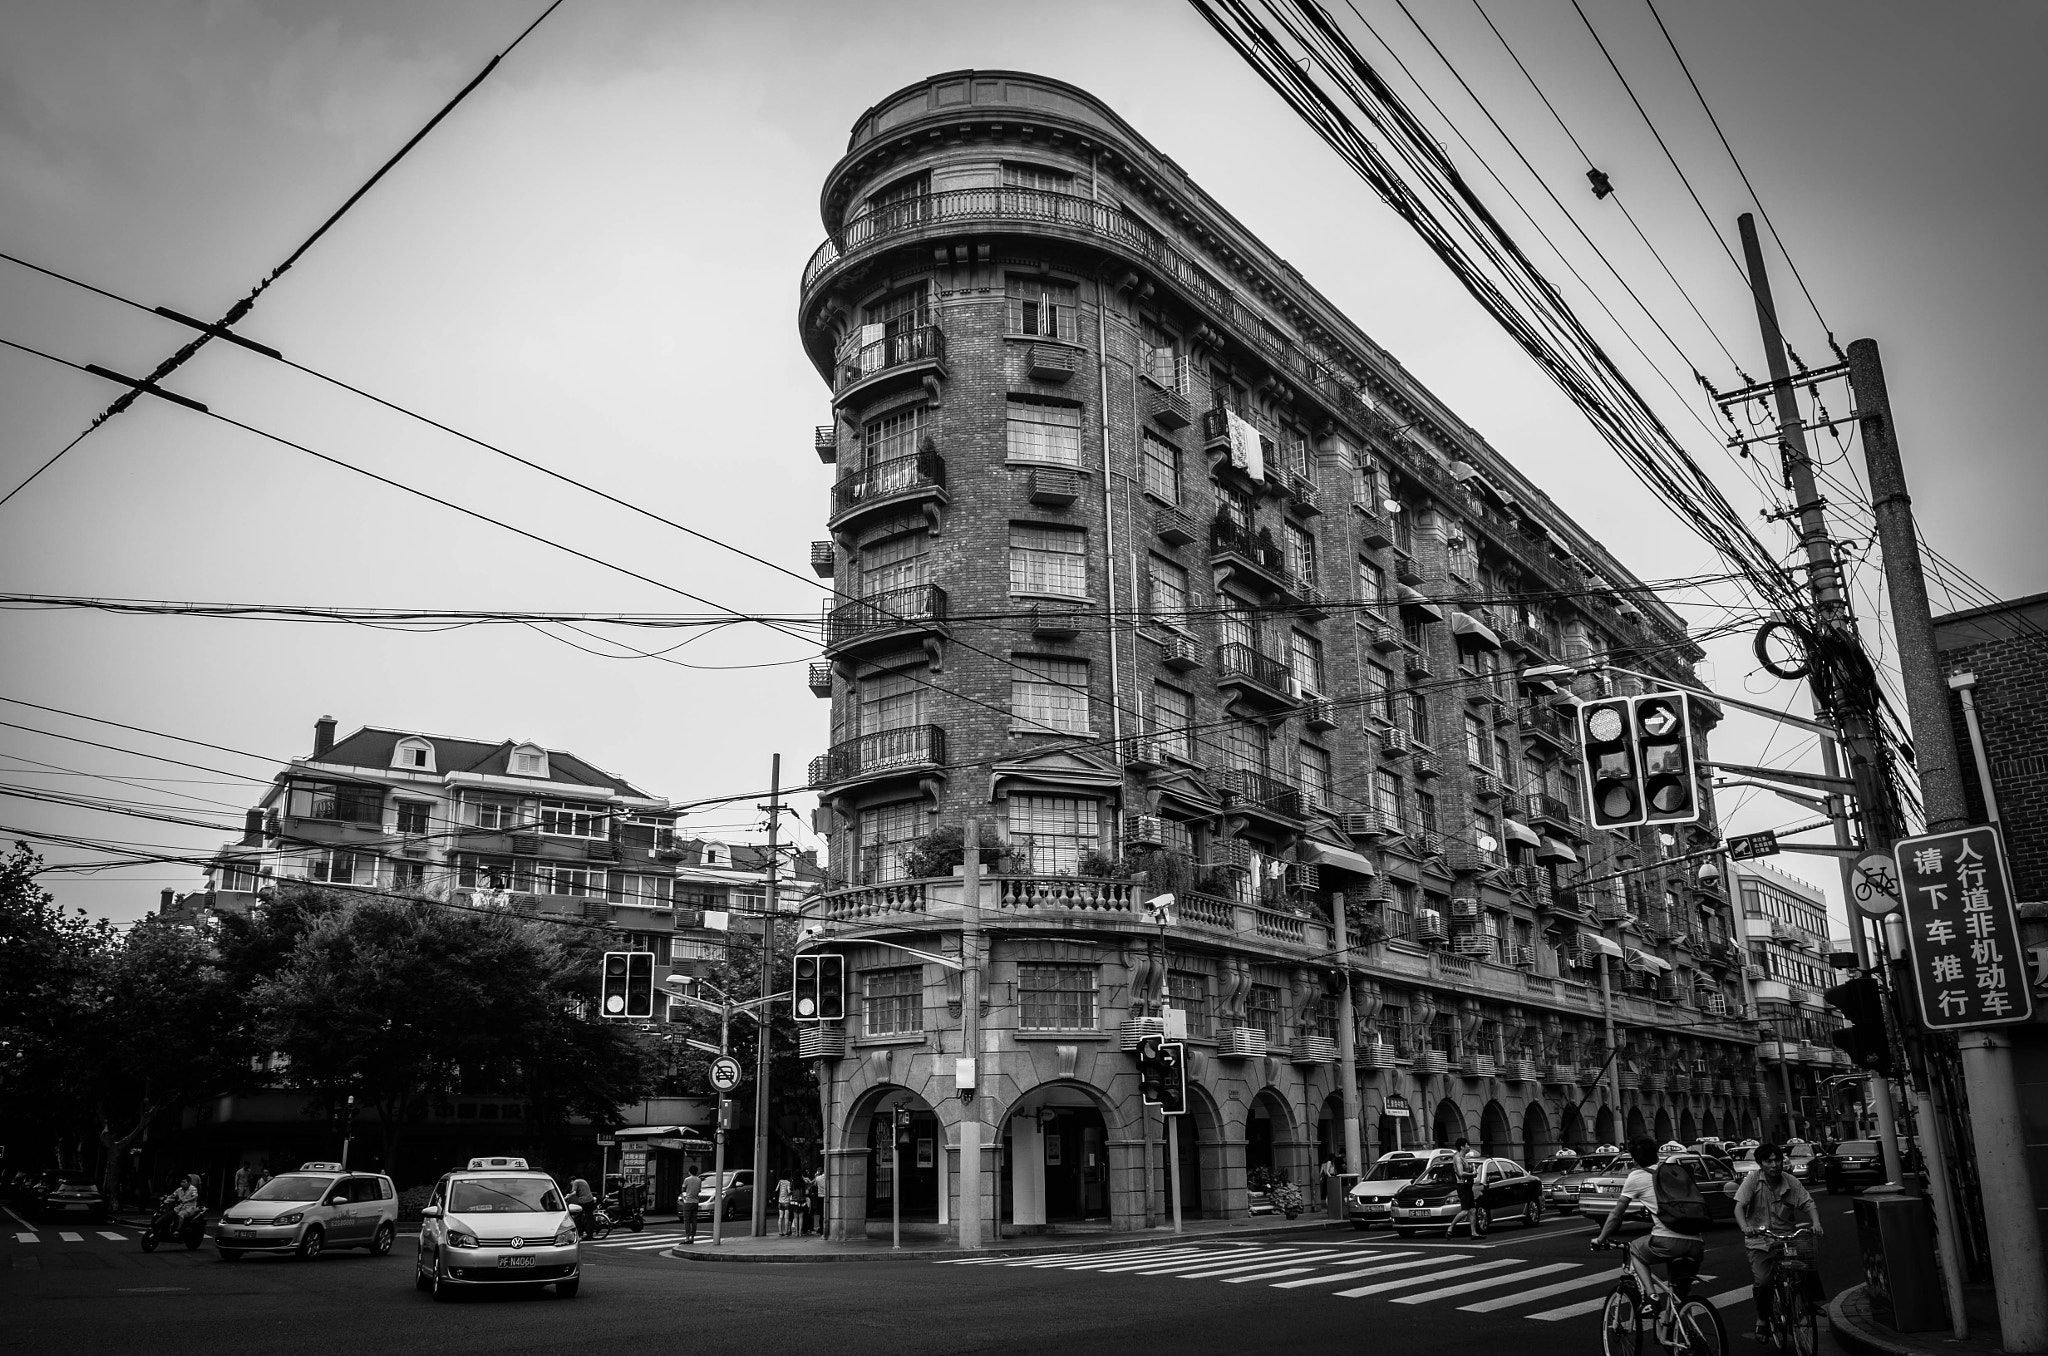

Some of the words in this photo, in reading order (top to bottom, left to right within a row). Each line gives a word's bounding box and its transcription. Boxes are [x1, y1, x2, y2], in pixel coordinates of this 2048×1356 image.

[1913, 847, 1969, 1018] 请下车推行
[1954, 837, 2013, 1016] 人行道非机动车
